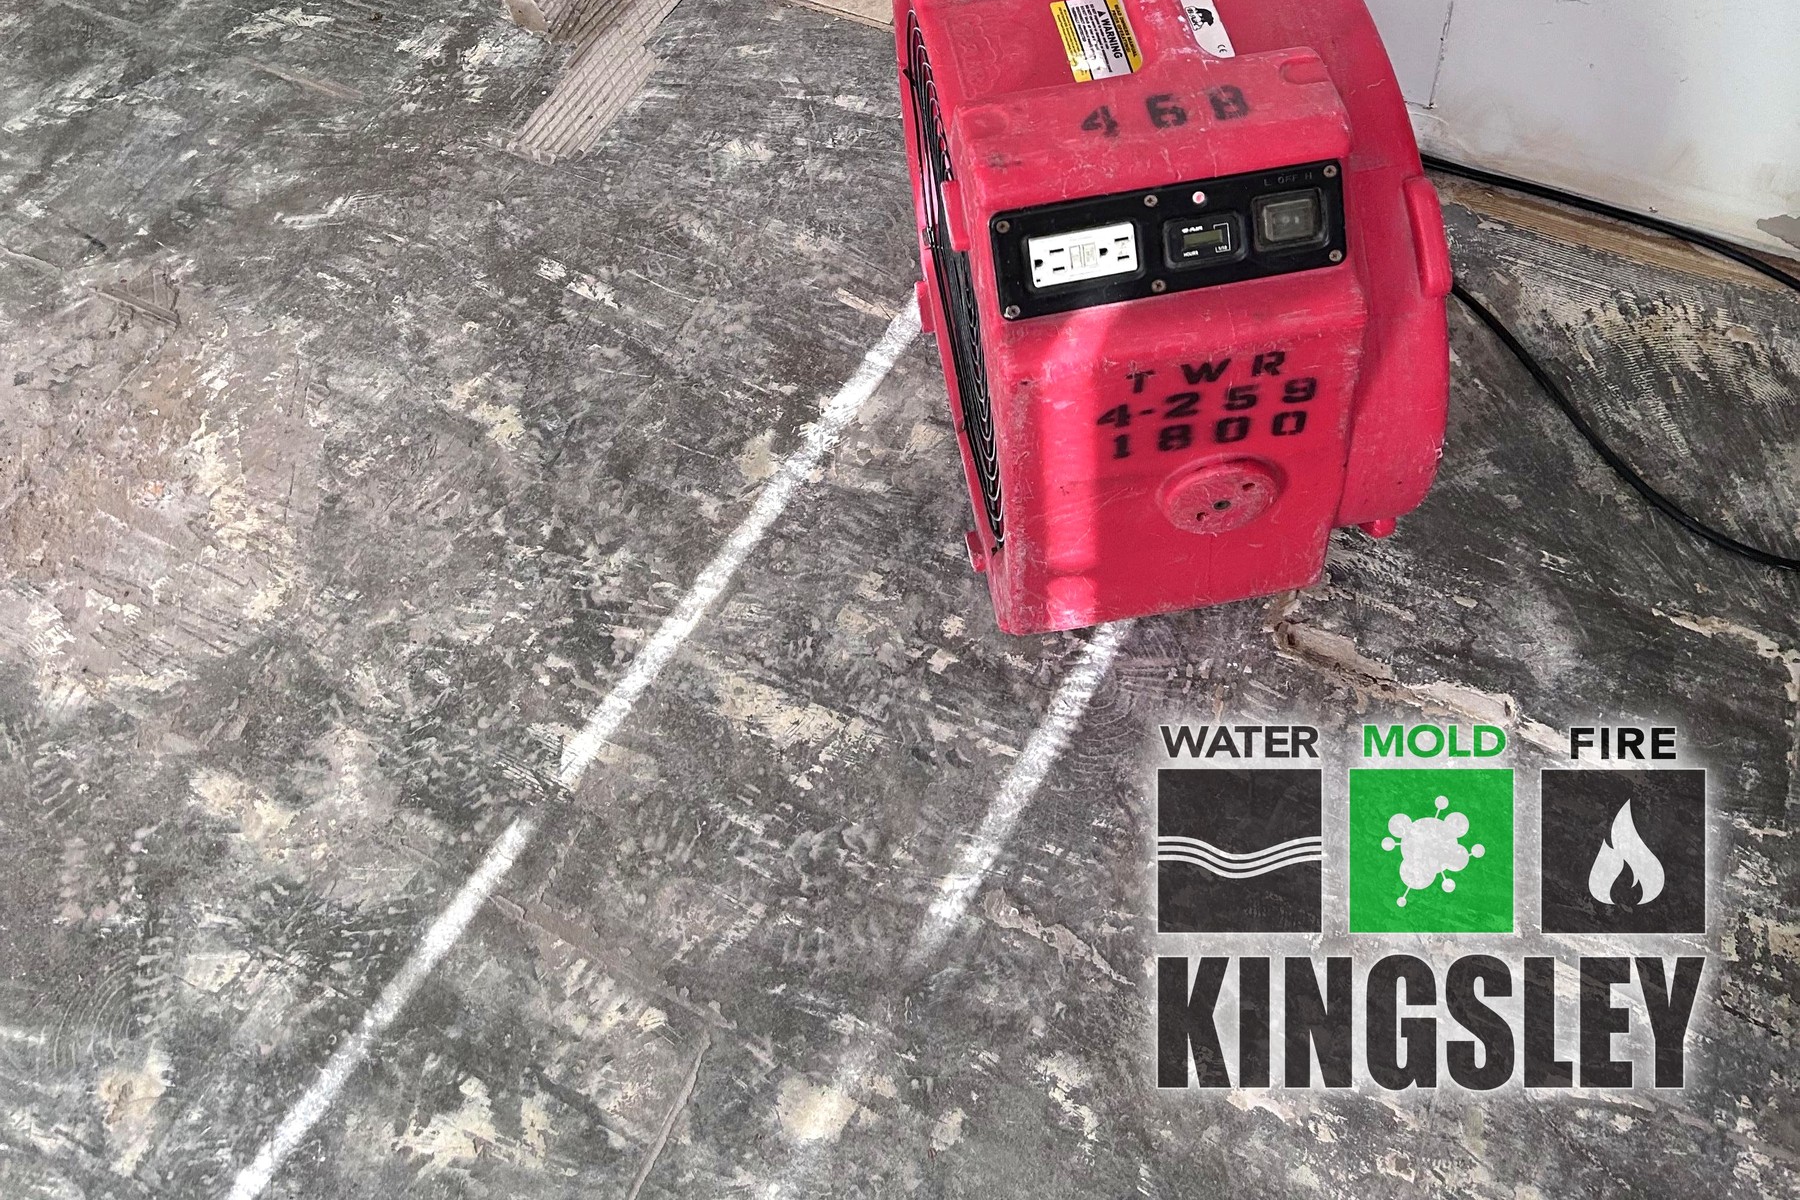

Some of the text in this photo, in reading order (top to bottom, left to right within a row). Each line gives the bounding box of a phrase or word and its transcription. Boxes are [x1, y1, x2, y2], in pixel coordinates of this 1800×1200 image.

[1101, 18, 1123, 59] WARNING
[1277, 174, 1297, 184] OFF
[1113, 411, 1307, 459] 1800
